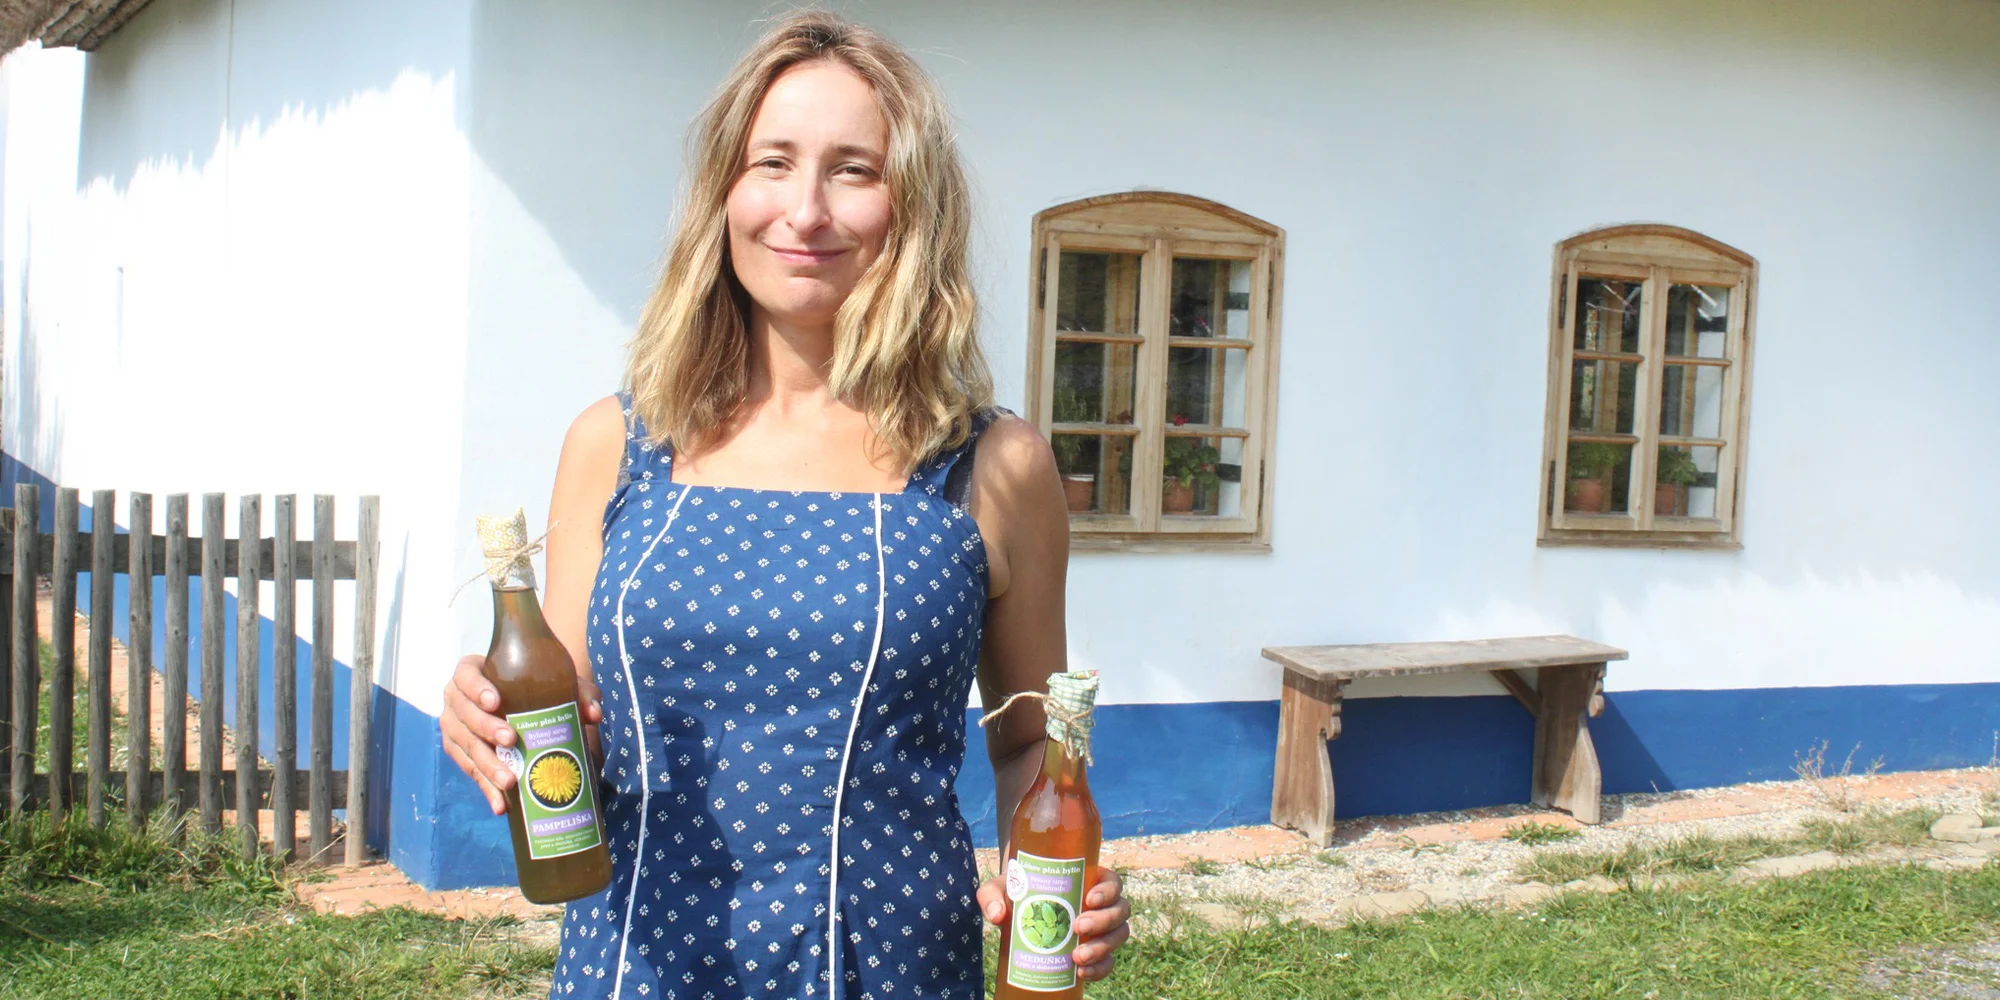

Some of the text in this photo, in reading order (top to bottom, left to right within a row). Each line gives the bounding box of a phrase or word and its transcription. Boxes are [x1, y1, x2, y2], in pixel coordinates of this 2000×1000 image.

[532, 813, 593, 833] PAMPELIŠKA
[1042, 866, 1060, 875] plná
[1062, 866, 1081, 876] bylin
